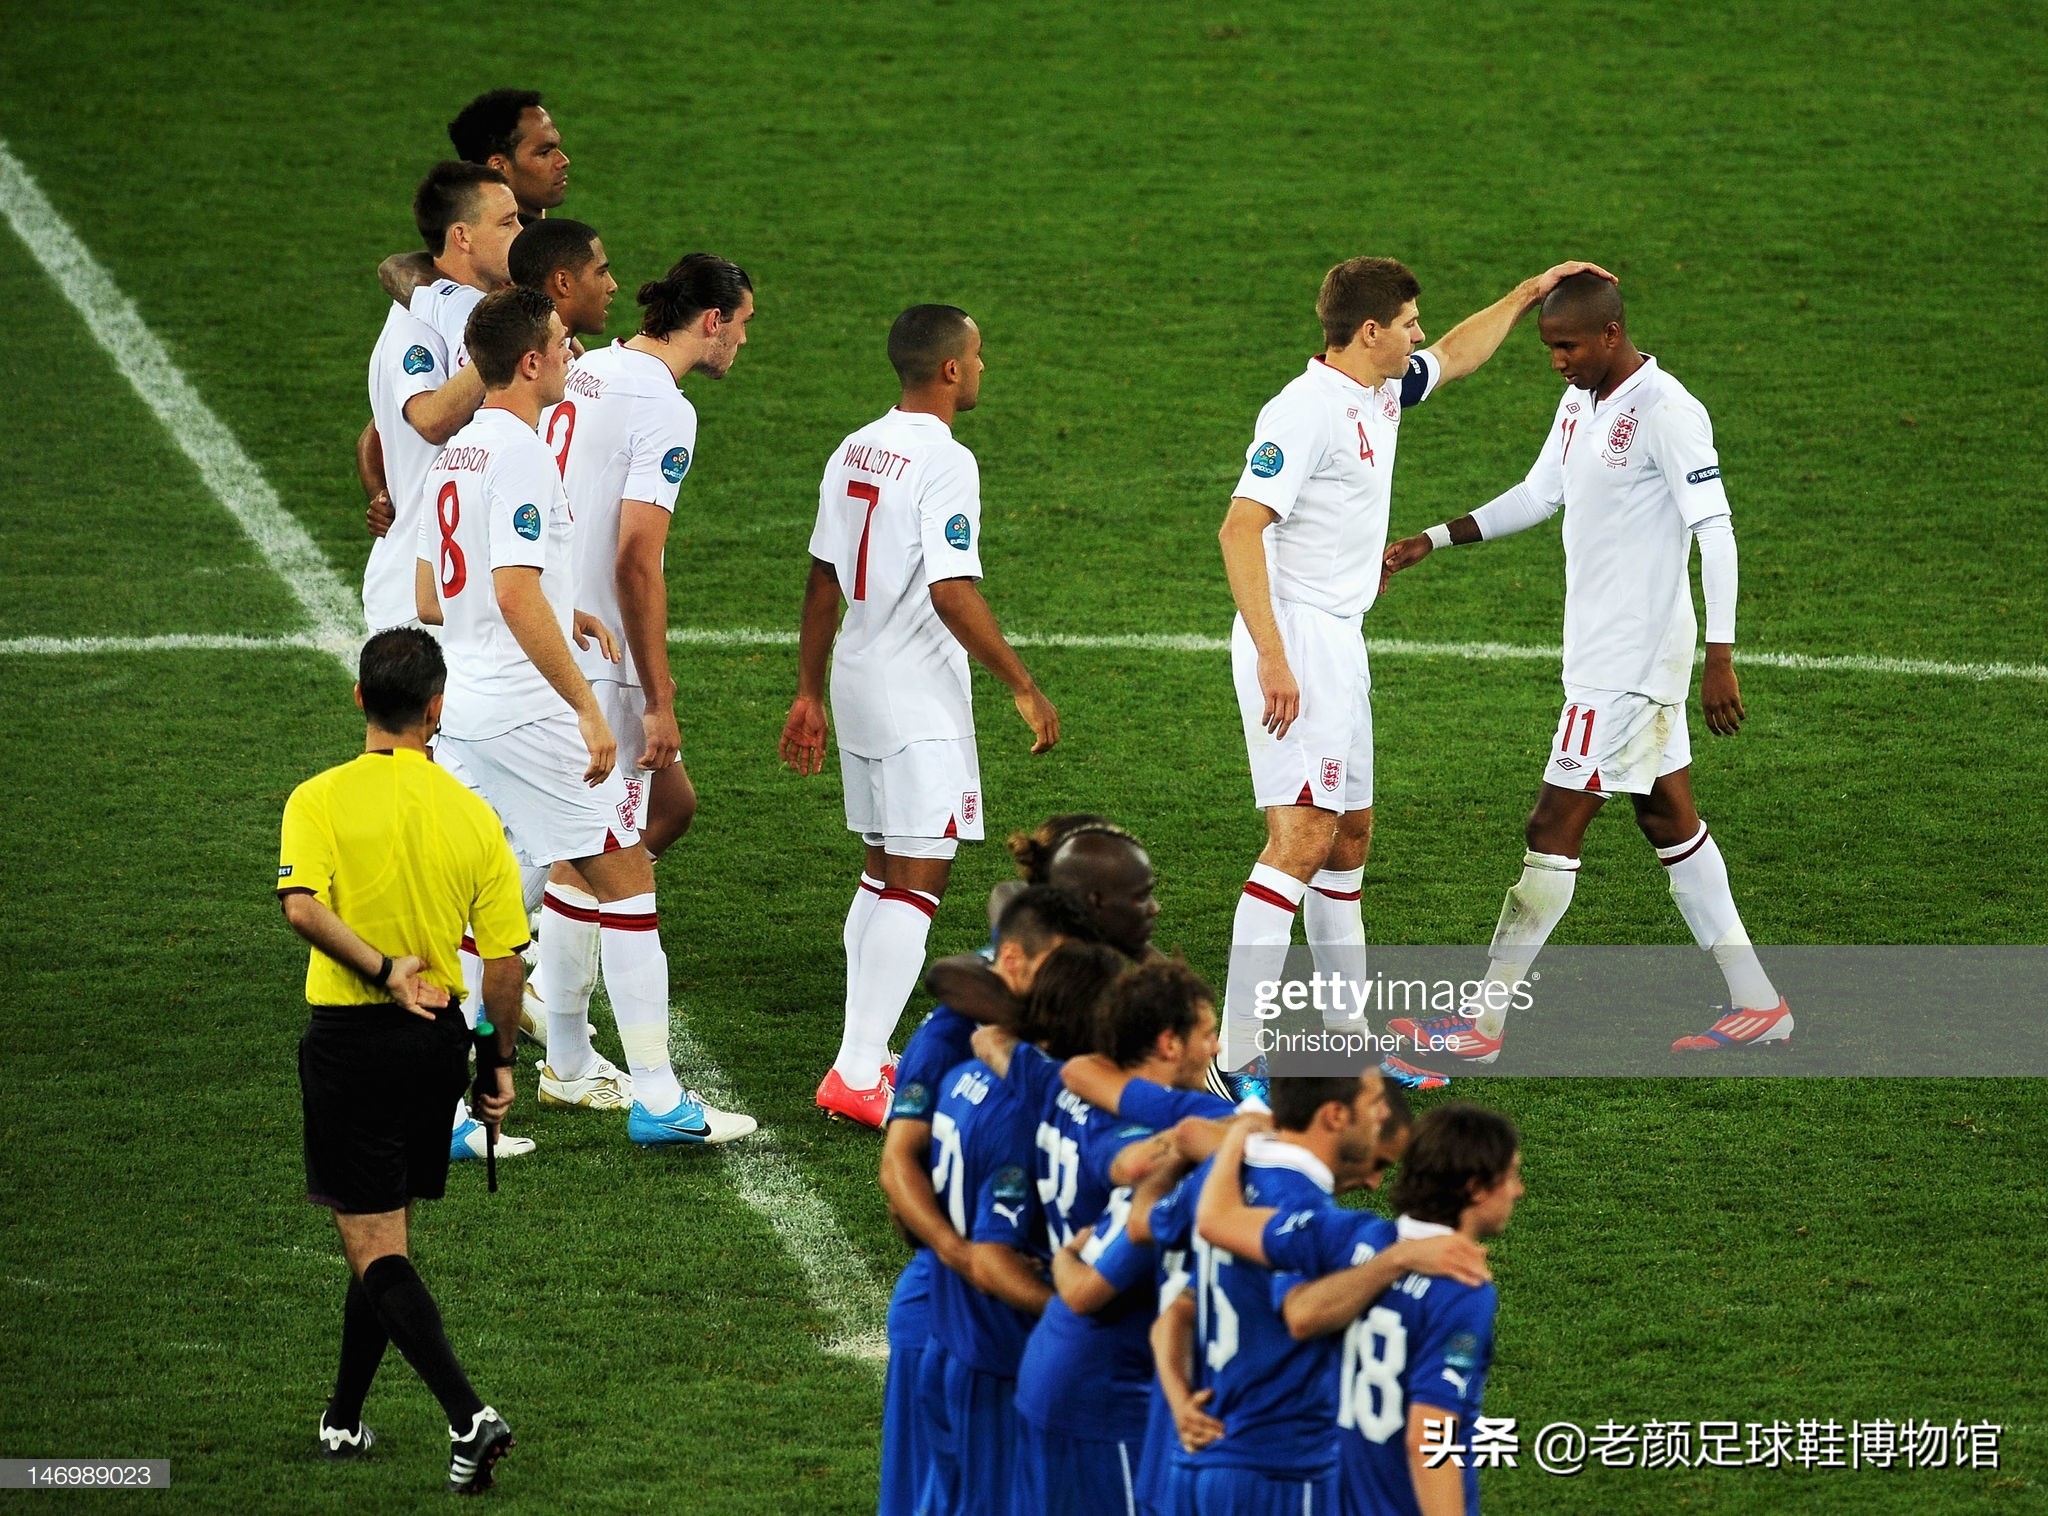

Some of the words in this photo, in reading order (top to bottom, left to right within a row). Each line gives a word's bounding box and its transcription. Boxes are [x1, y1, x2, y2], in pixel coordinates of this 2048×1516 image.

[567, 364, 609, 400] ARROLL
[842, 443, 911, 482] WALCOTT
[1357, 421, 1374, 468] 4
[1561, 417, 1577, 466] 11
[436, 480, 467, 600] 8
[846, 479, 881, 602] 7
[1561, 704, 1596, 757] 11
[931, 1111, 966, 1238] 21
[1337, 1305, 1408, 1445] 18
